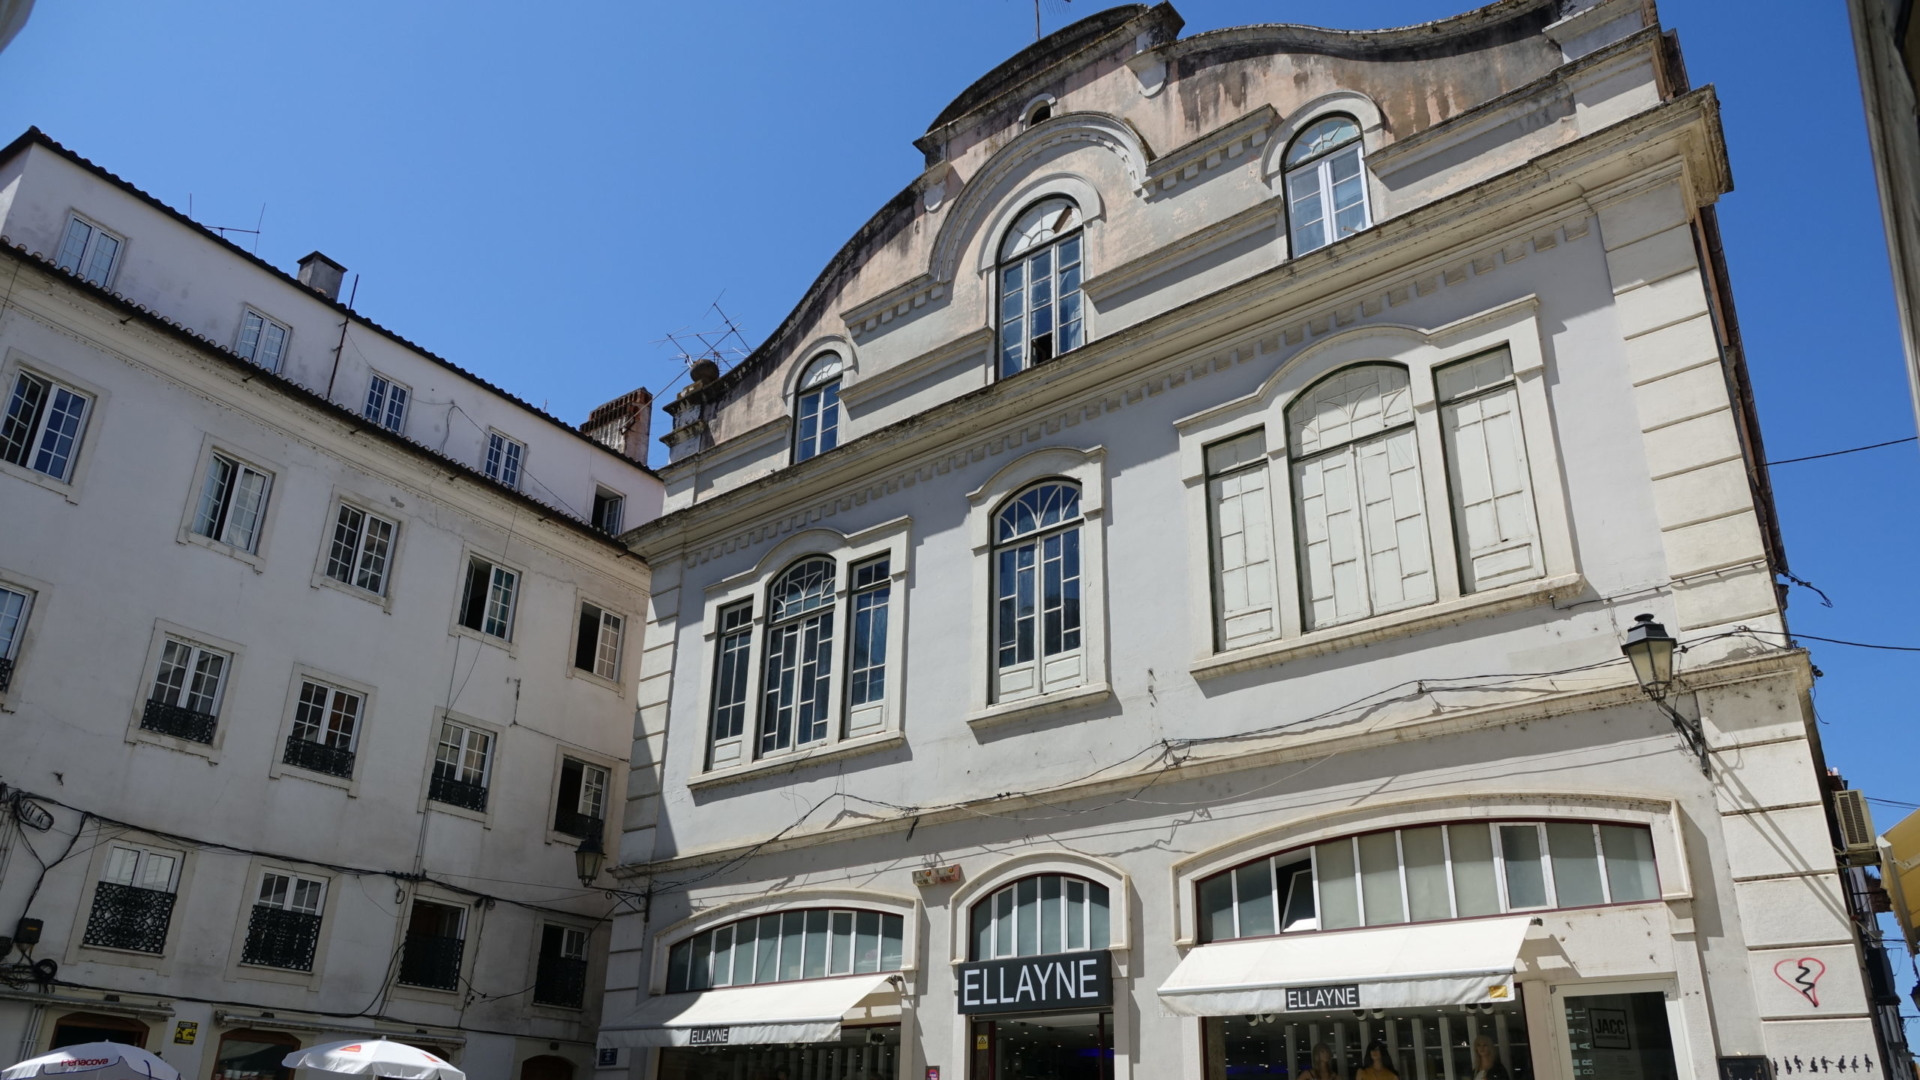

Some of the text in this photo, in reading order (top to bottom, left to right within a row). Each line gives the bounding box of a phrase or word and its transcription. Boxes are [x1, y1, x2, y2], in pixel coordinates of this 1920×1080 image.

[964, 959, 1098, 1006] ELLAYNE
[1288, 987, 1356, 1008] ELLAYNE
[691, 1028, 728, 1043] ELLAYNE
[1595, 1018, 1626, 1035] JACC
[1574, 1007, 1595, 1075] BRAZIL
